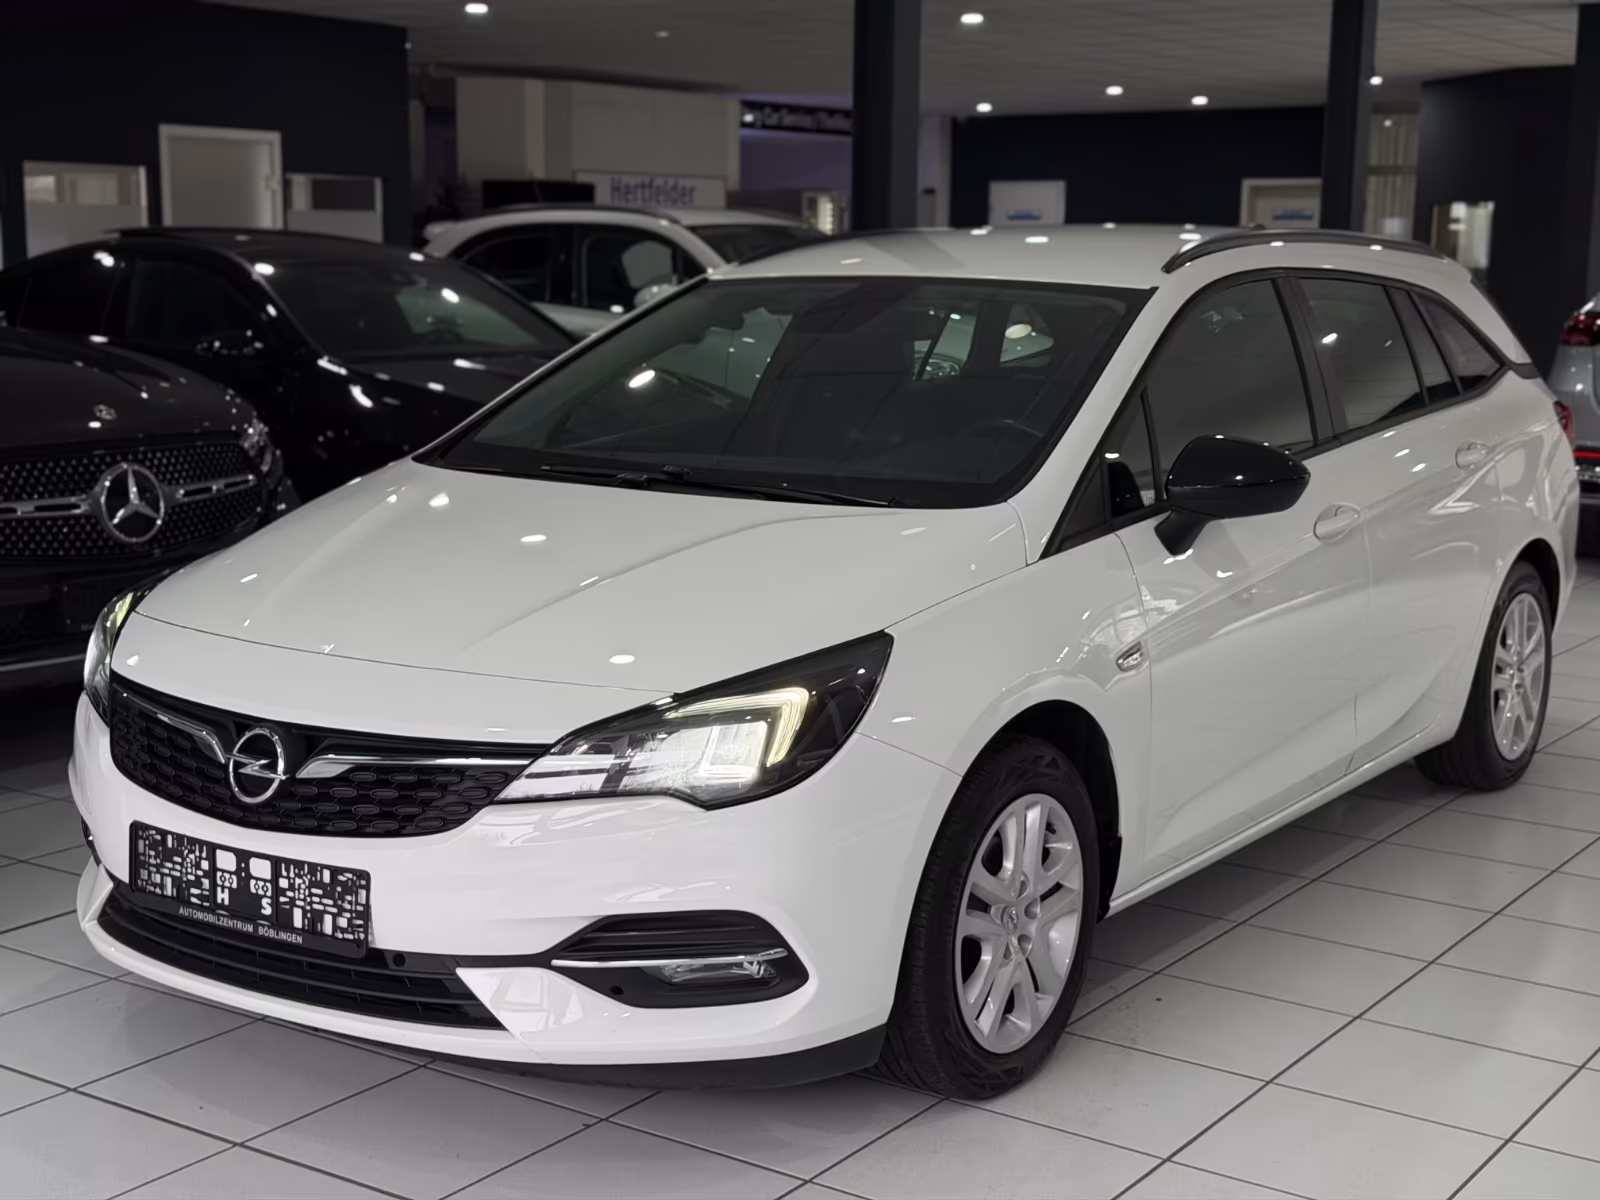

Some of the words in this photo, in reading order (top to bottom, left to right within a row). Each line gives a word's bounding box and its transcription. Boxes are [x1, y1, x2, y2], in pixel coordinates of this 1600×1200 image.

[609, 176, 696, 206] Hertfelder
[178, 905, 254, 933] AUTOMOBILZENTRUM
[258, 926, 303, 944] BÖBLINGEN
